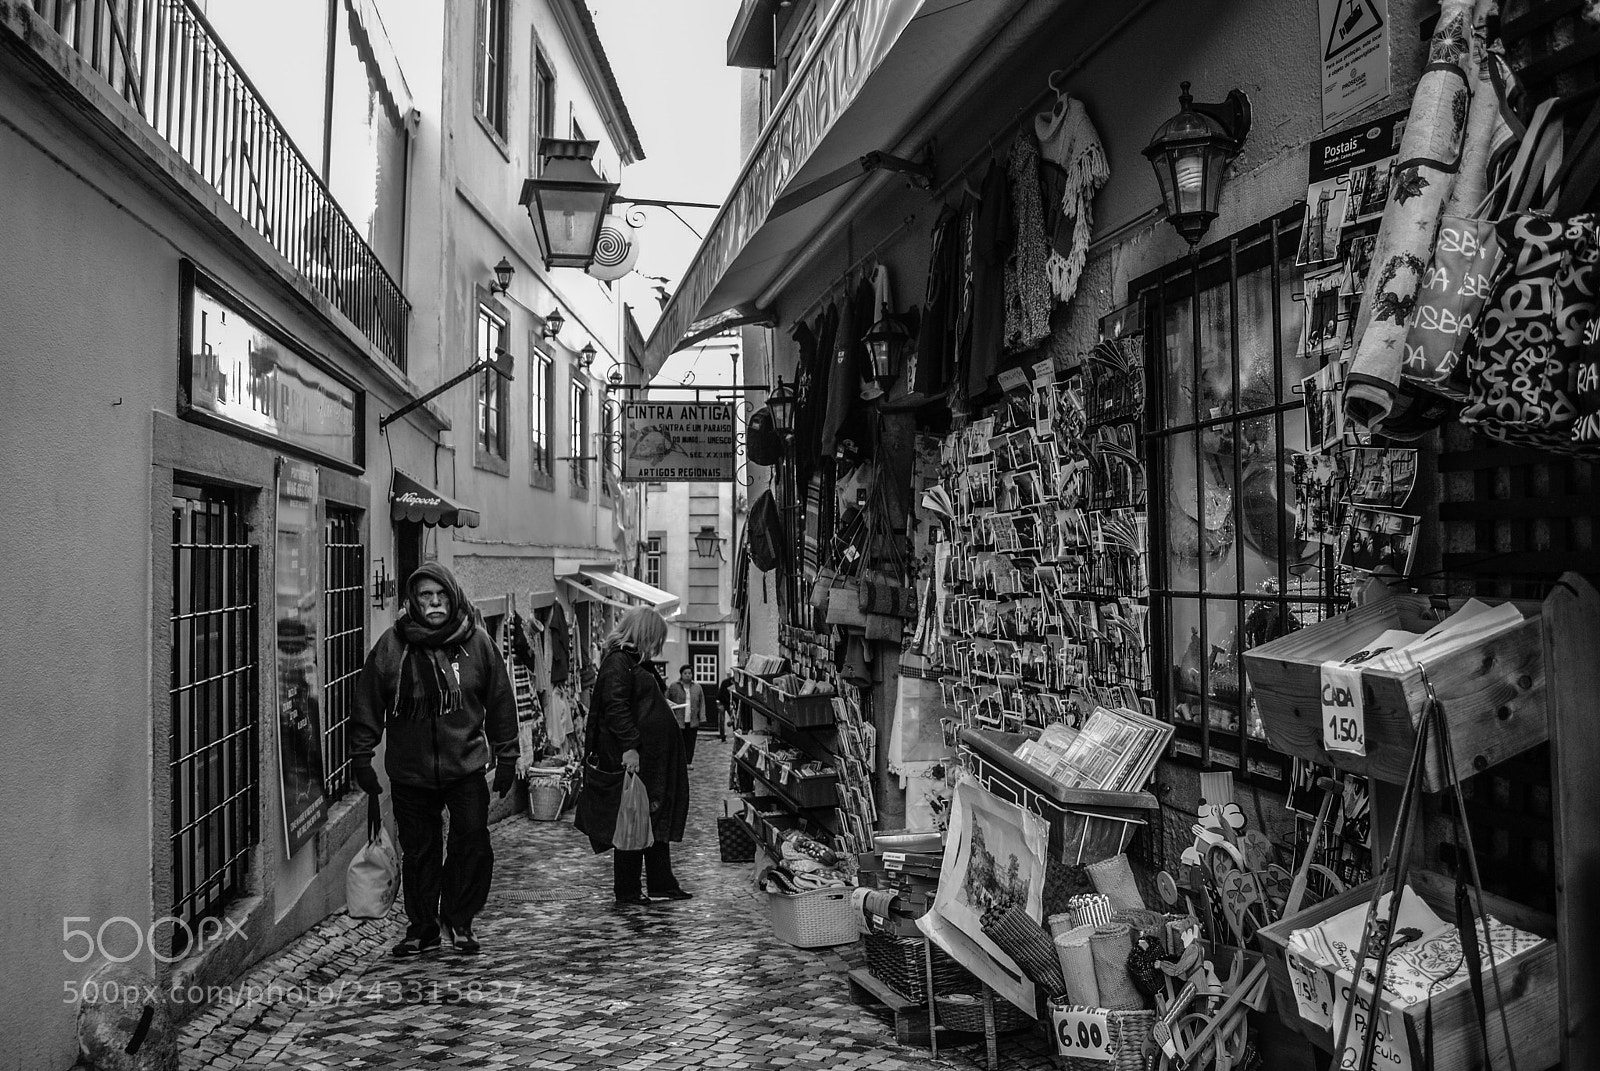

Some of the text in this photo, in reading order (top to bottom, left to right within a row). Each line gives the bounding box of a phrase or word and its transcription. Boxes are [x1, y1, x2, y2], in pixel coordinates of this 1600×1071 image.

[1324, 138, 1358, 159] Postais
[627, 406, 731, 420] CINTRA ANTIGA
[658, 424, 684, 432] SINTRA
[708, 436, 732, 444] UNESCO
[638, 468, 721, 477] ARTIGOS REGIONAIS
[1322, 684, 1354, 708] CADA
